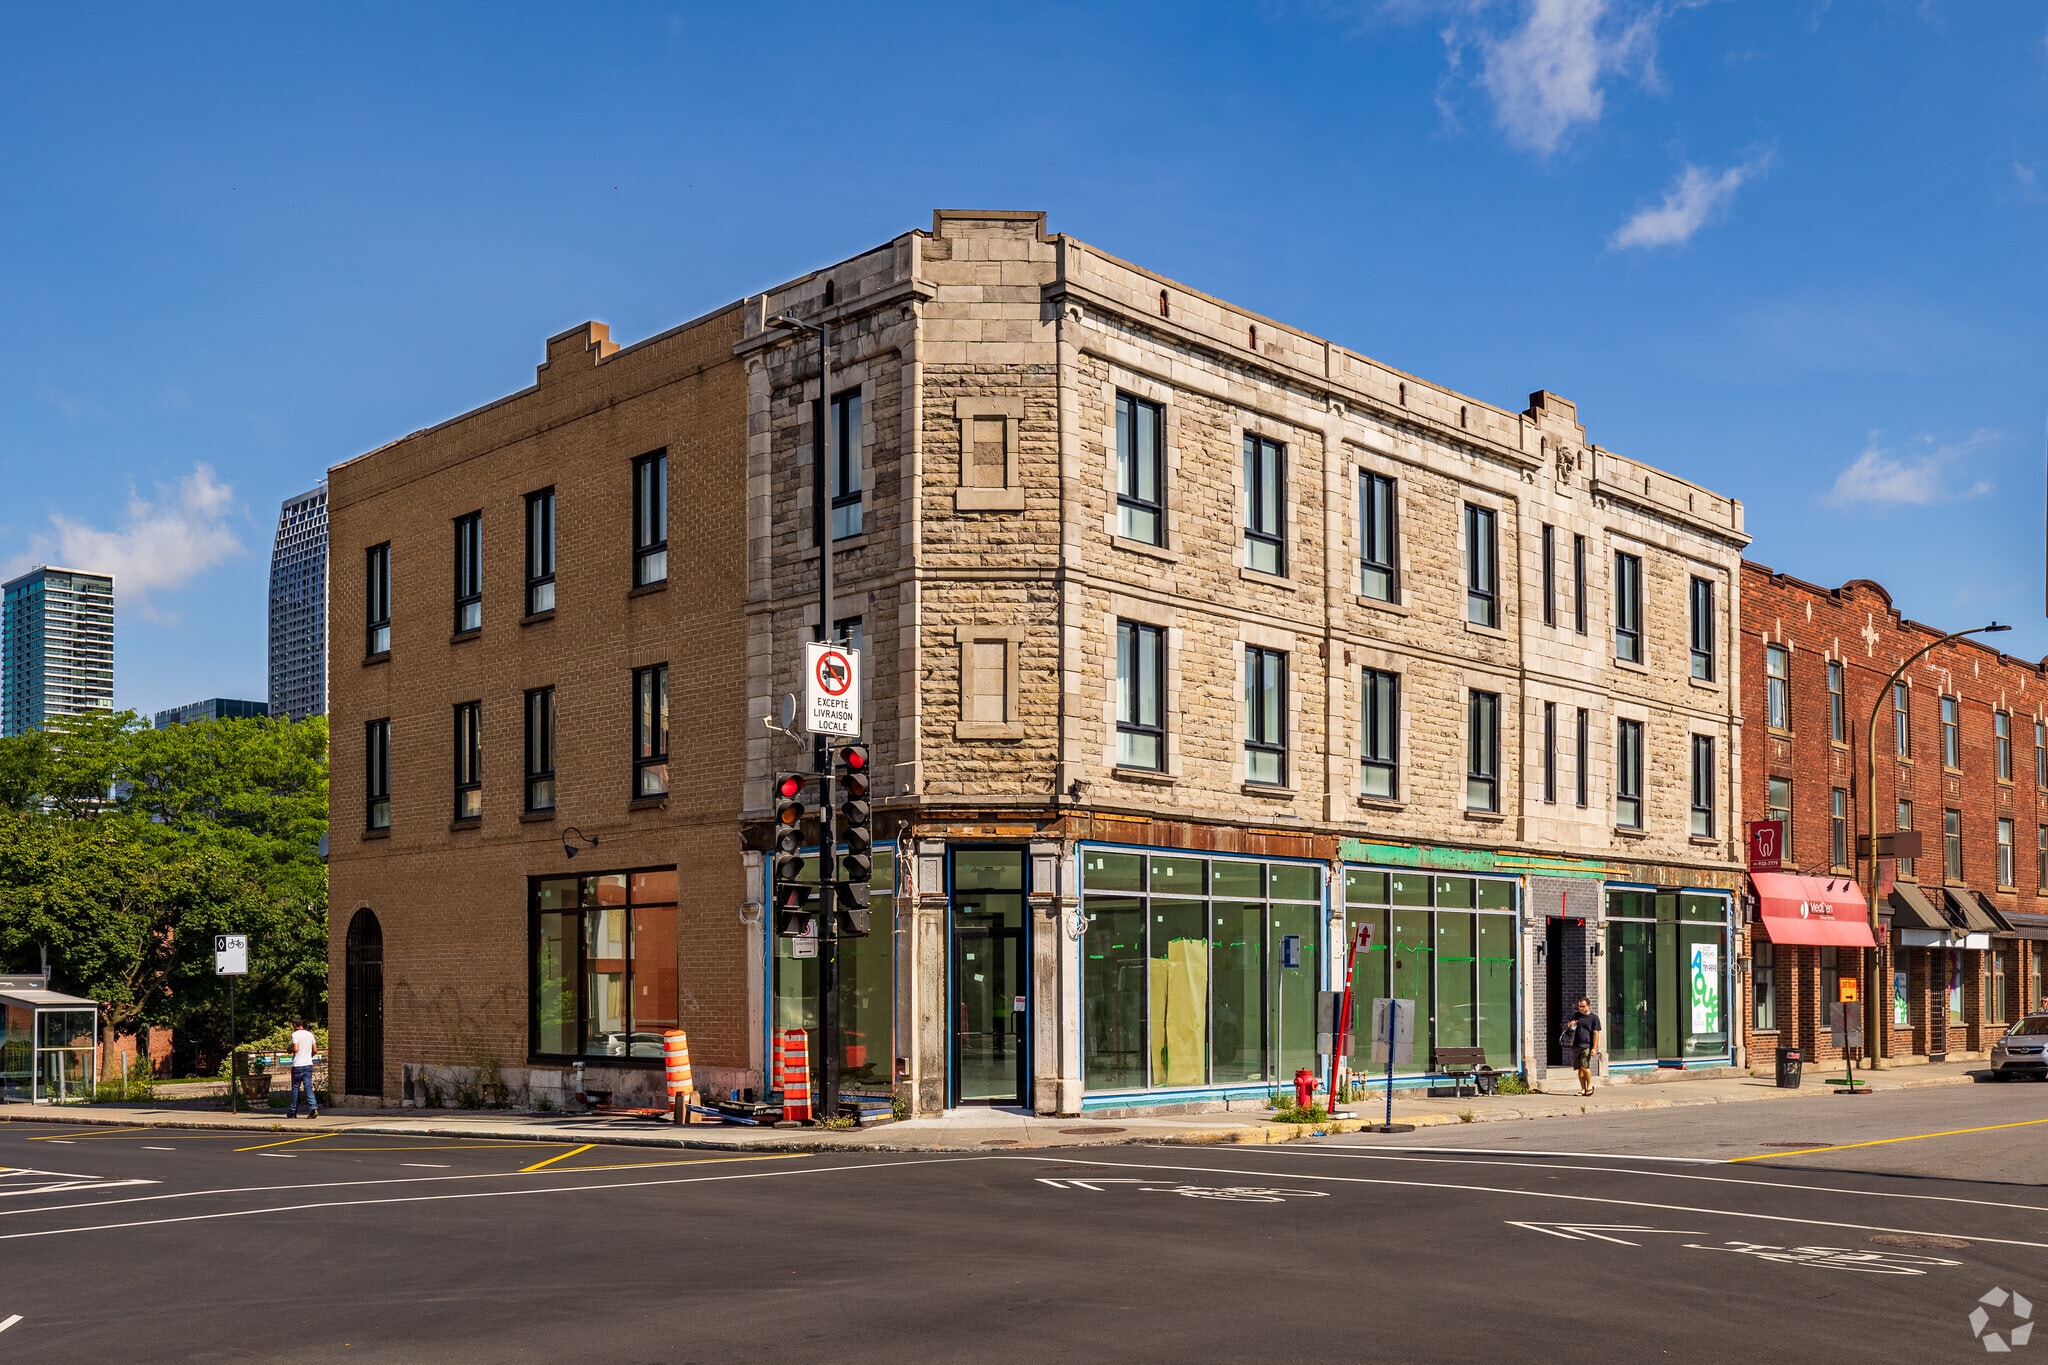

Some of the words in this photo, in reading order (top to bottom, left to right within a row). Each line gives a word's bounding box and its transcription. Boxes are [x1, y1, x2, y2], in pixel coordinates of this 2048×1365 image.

[817, 697, 849, 710] EXCEPTÉ
[813, 708, 853, 721] LIVRAISON
[818, 719, 848, 732] LOCALE
